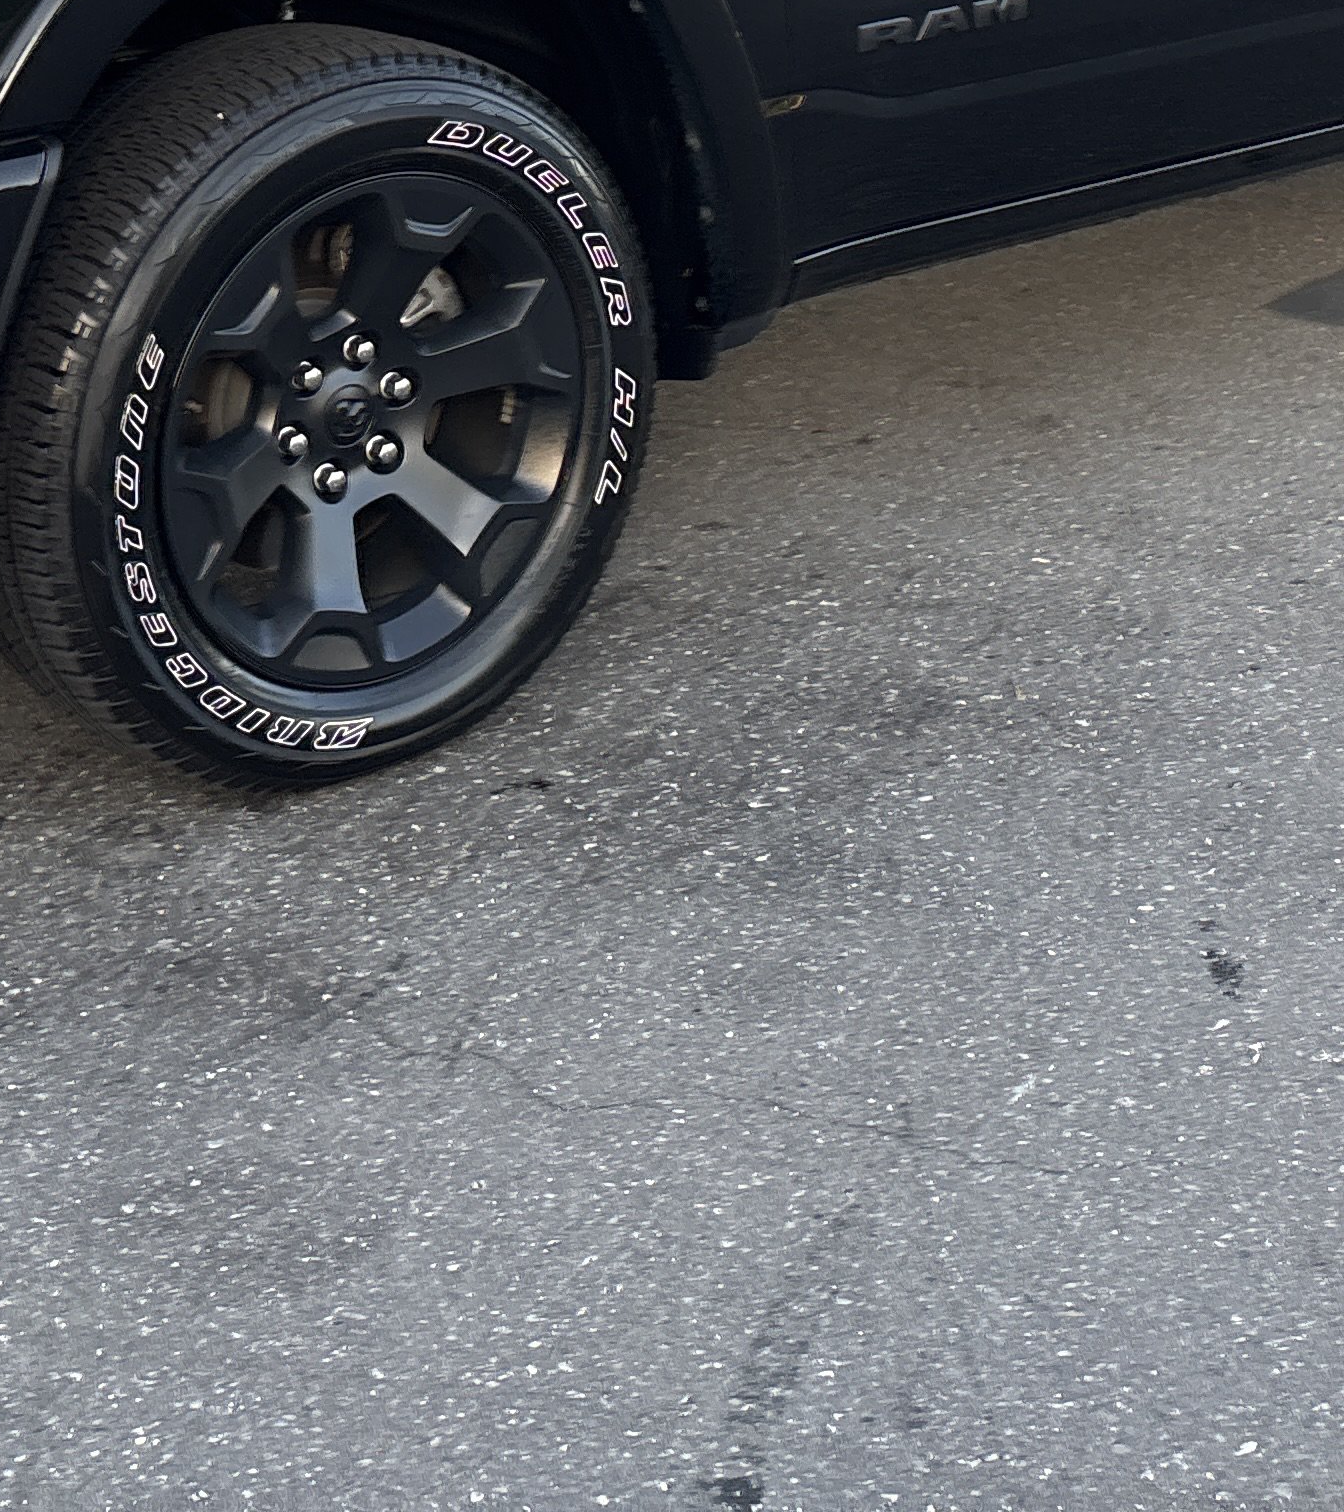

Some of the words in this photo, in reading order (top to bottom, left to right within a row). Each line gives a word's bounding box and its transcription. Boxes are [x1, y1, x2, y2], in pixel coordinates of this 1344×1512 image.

[427, 120, 634, 327] DUELER
[594, 368, 638, 506] H/L
[112, 332, 375, 750] BRIDGESTONE
